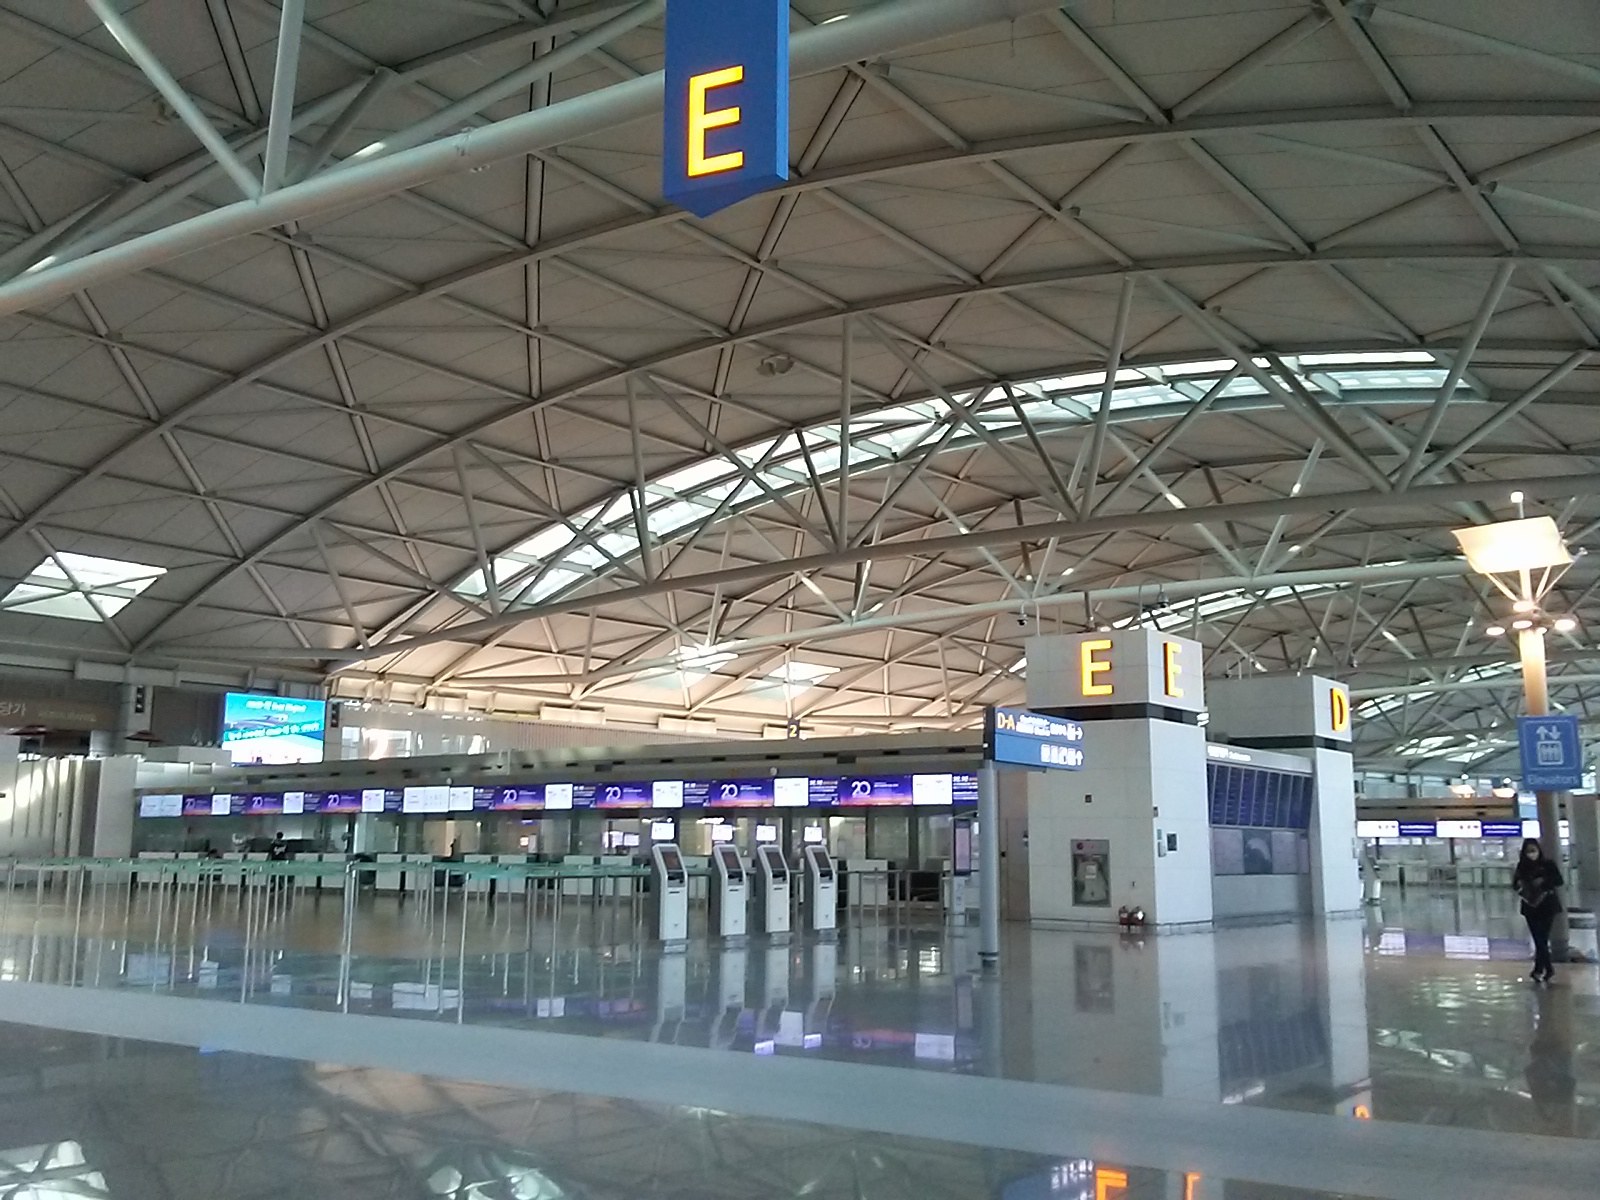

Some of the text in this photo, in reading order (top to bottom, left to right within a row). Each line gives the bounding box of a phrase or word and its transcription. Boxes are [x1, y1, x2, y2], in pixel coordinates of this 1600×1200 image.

[687, 65, 744, 178] E
[1081, 639, 1114, 696] E
[1163, 641, 1184, 698] E
[1330, 687, 1350, 732] D
[789, 724, 797, 737] 2
[503, 789, 517, 803] 20
[605, 786, 621, 800] 20
[721, 784, 738, 799] 20
[853, 781, 871, 797] 20
[328, 794, 339, 807] 20
